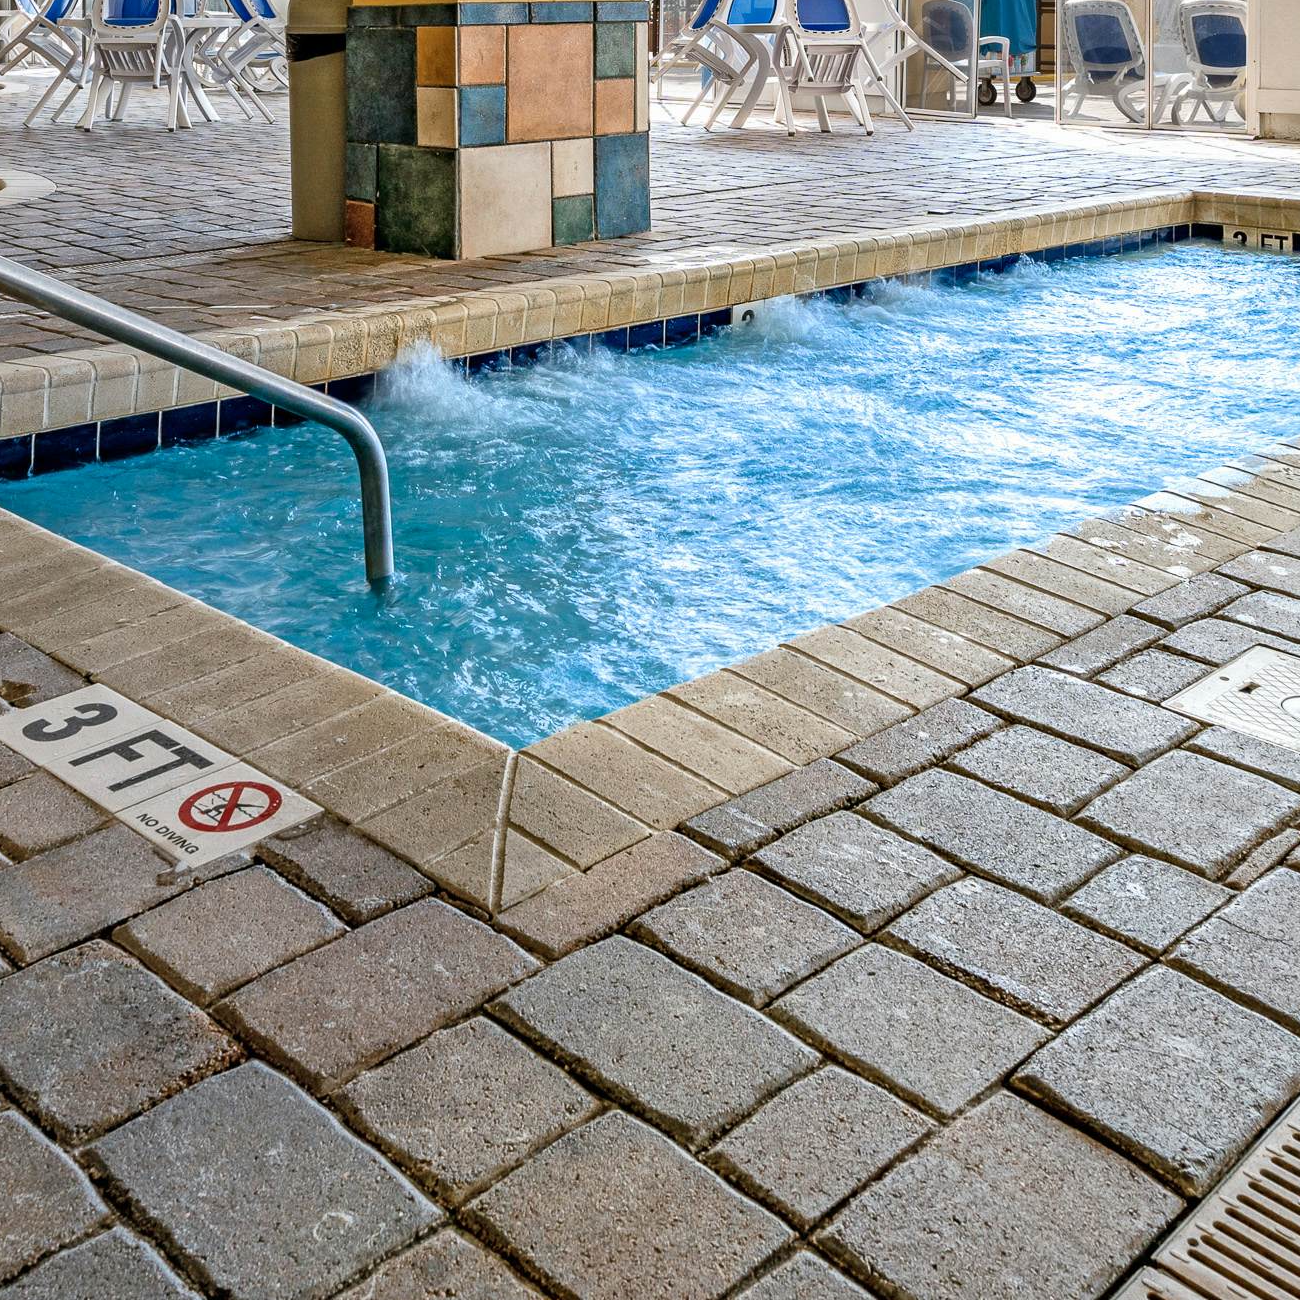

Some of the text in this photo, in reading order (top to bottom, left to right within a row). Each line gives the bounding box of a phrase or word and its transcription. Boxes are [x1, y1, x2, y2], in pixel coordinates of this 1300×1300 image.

[22, 702, 215, 792] 3 FT
[136, 812, 200, 855] NO DIVING
